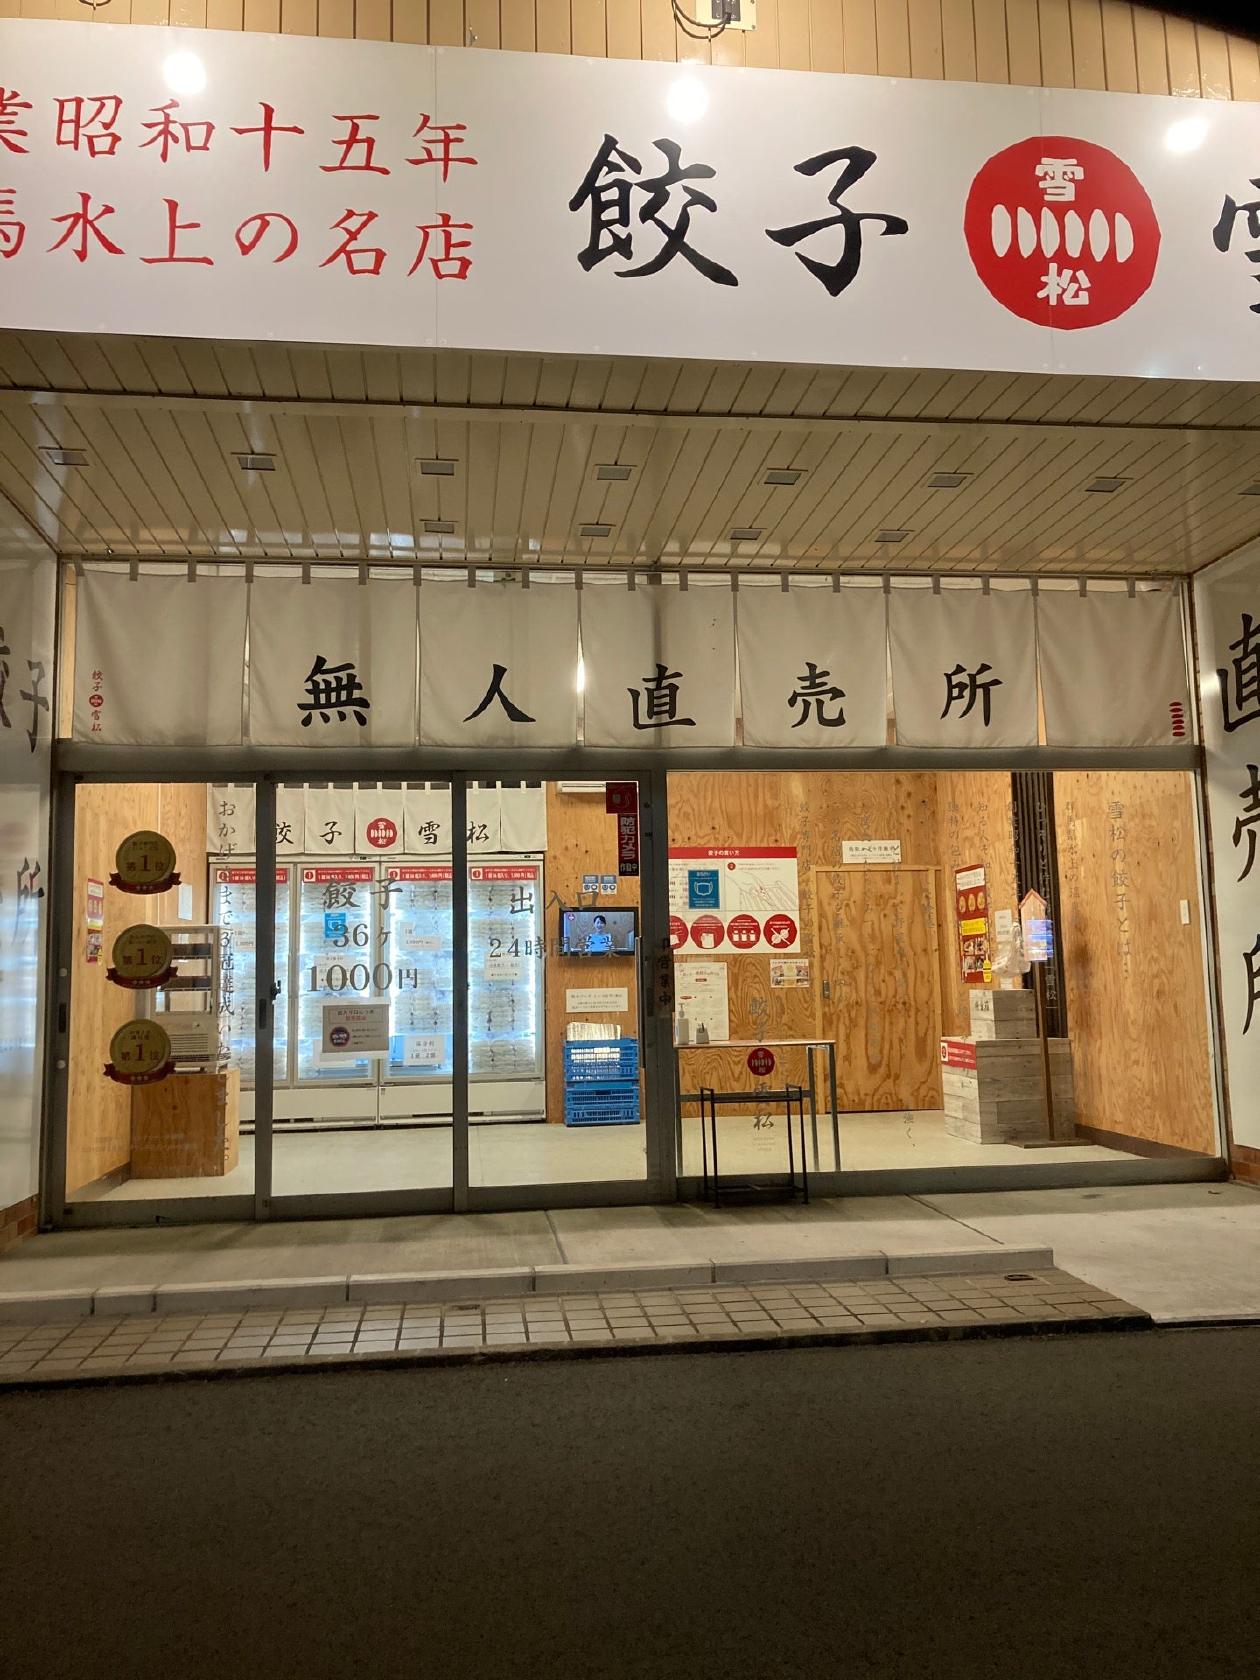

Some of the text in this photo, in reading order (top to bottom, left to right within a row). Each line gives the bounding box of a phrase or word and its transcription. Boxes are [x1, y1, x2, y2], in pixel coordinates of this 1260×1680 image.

[1035, 157, 1085, 202] 雪
[569, 133, 908, 297] 餃子
[1036, 263, 1090, 306] 松
[297, 654, 1002, 732] 無人直売所
[417, 820, 490, 845] 雪松
[323, 878, 403, 910] 餃子
[510, 886, 600, 914] 出入口
